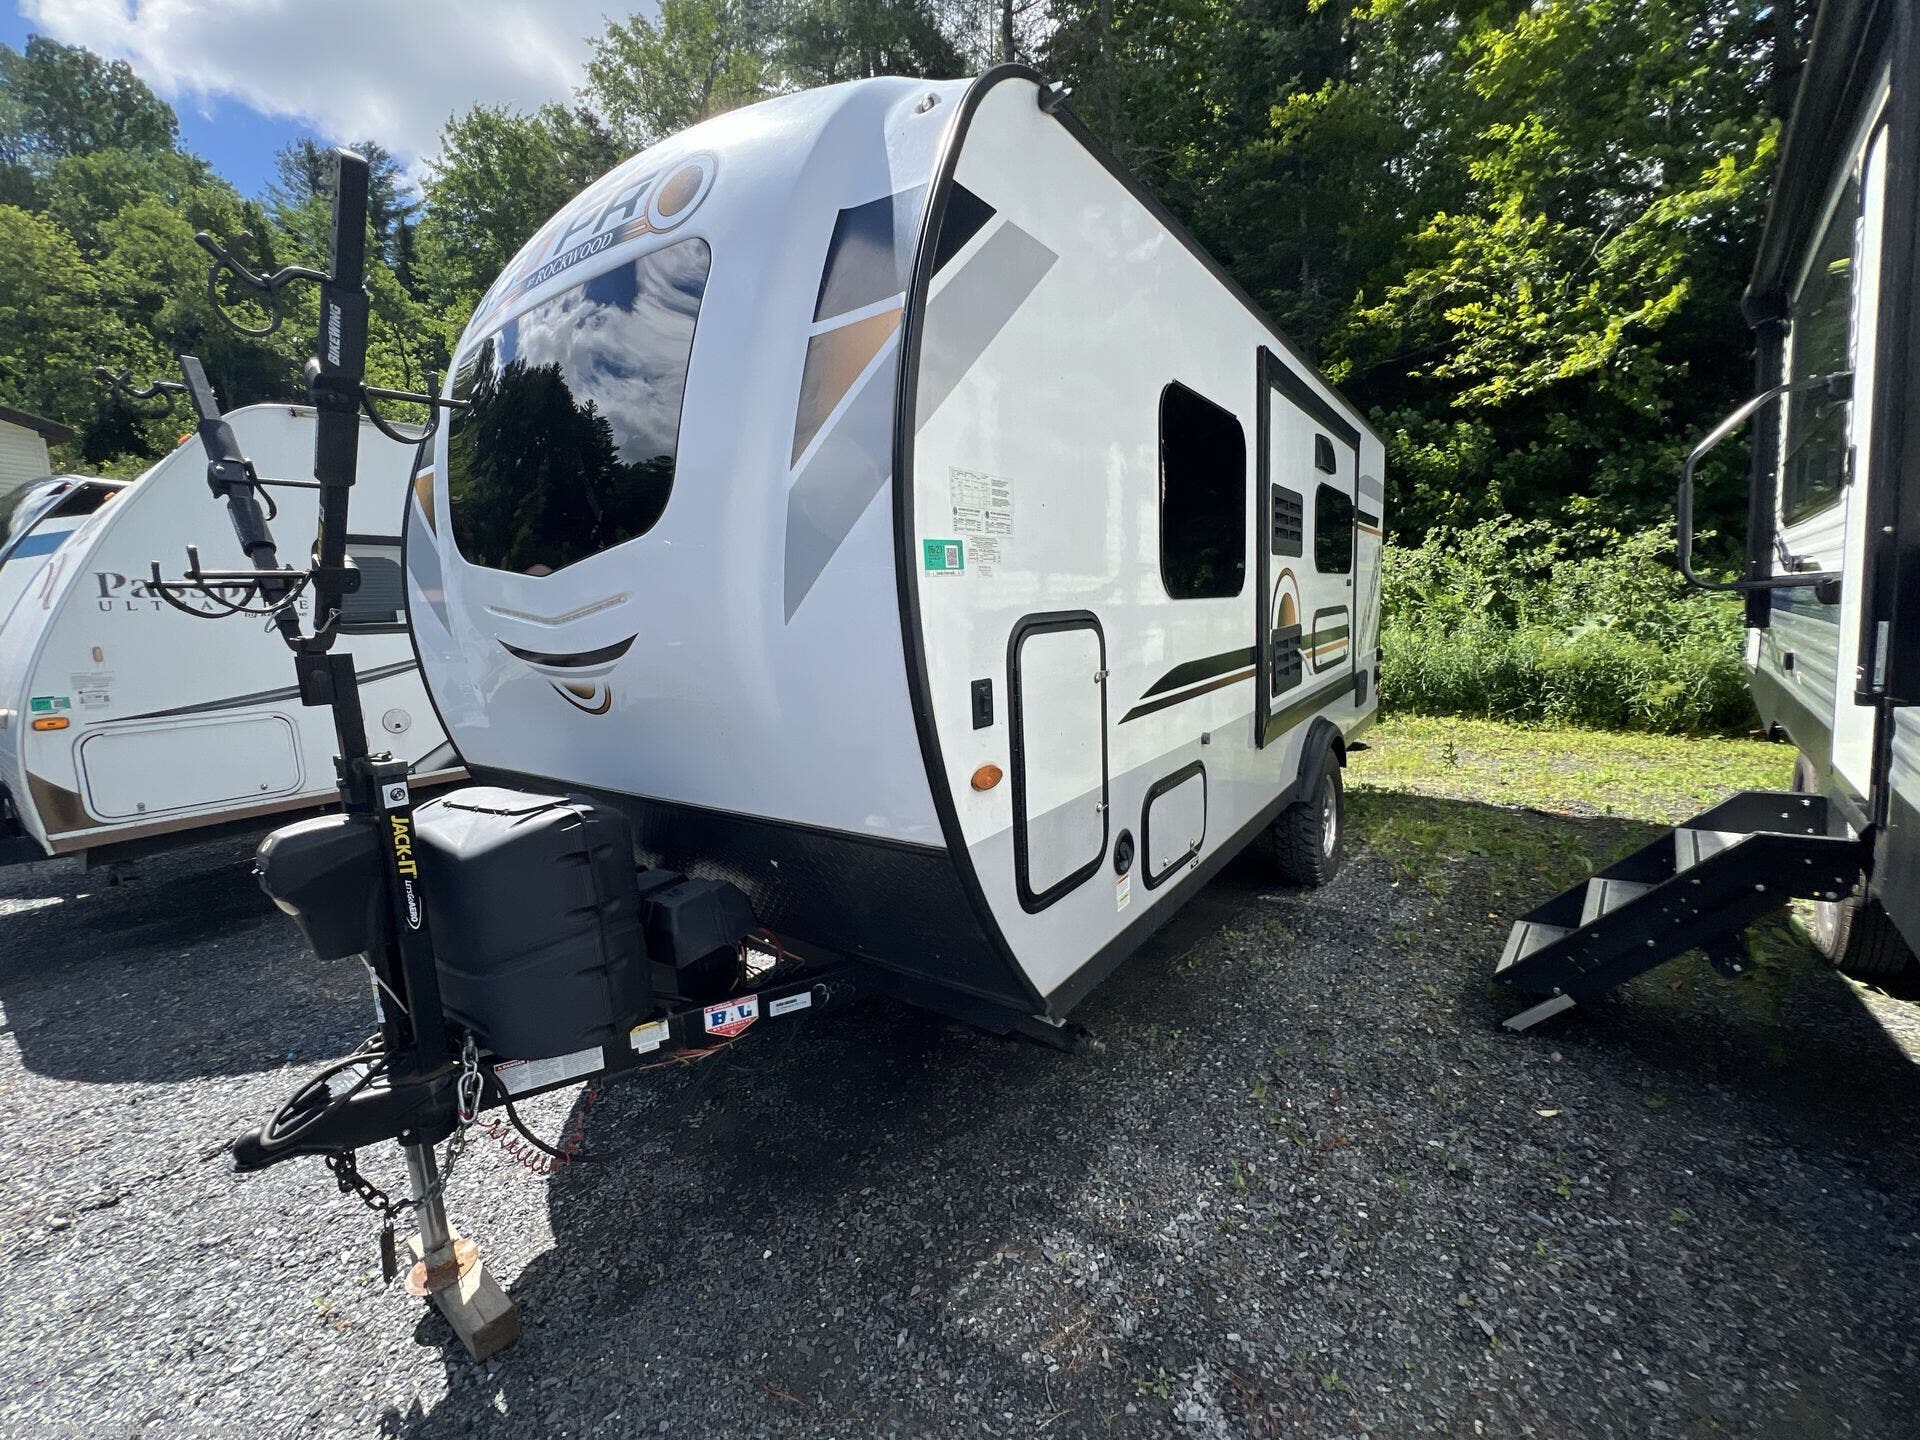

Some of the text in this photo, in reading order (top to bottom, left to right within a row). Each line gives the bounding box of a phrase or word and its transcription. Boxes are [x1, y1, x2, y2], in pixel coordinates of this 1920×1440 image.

[534, 232, 614, 284] ROCKWOOD
[327, 303, 342, 367] BIKEWING
[391, 815, 417, 877] JACK-IT
